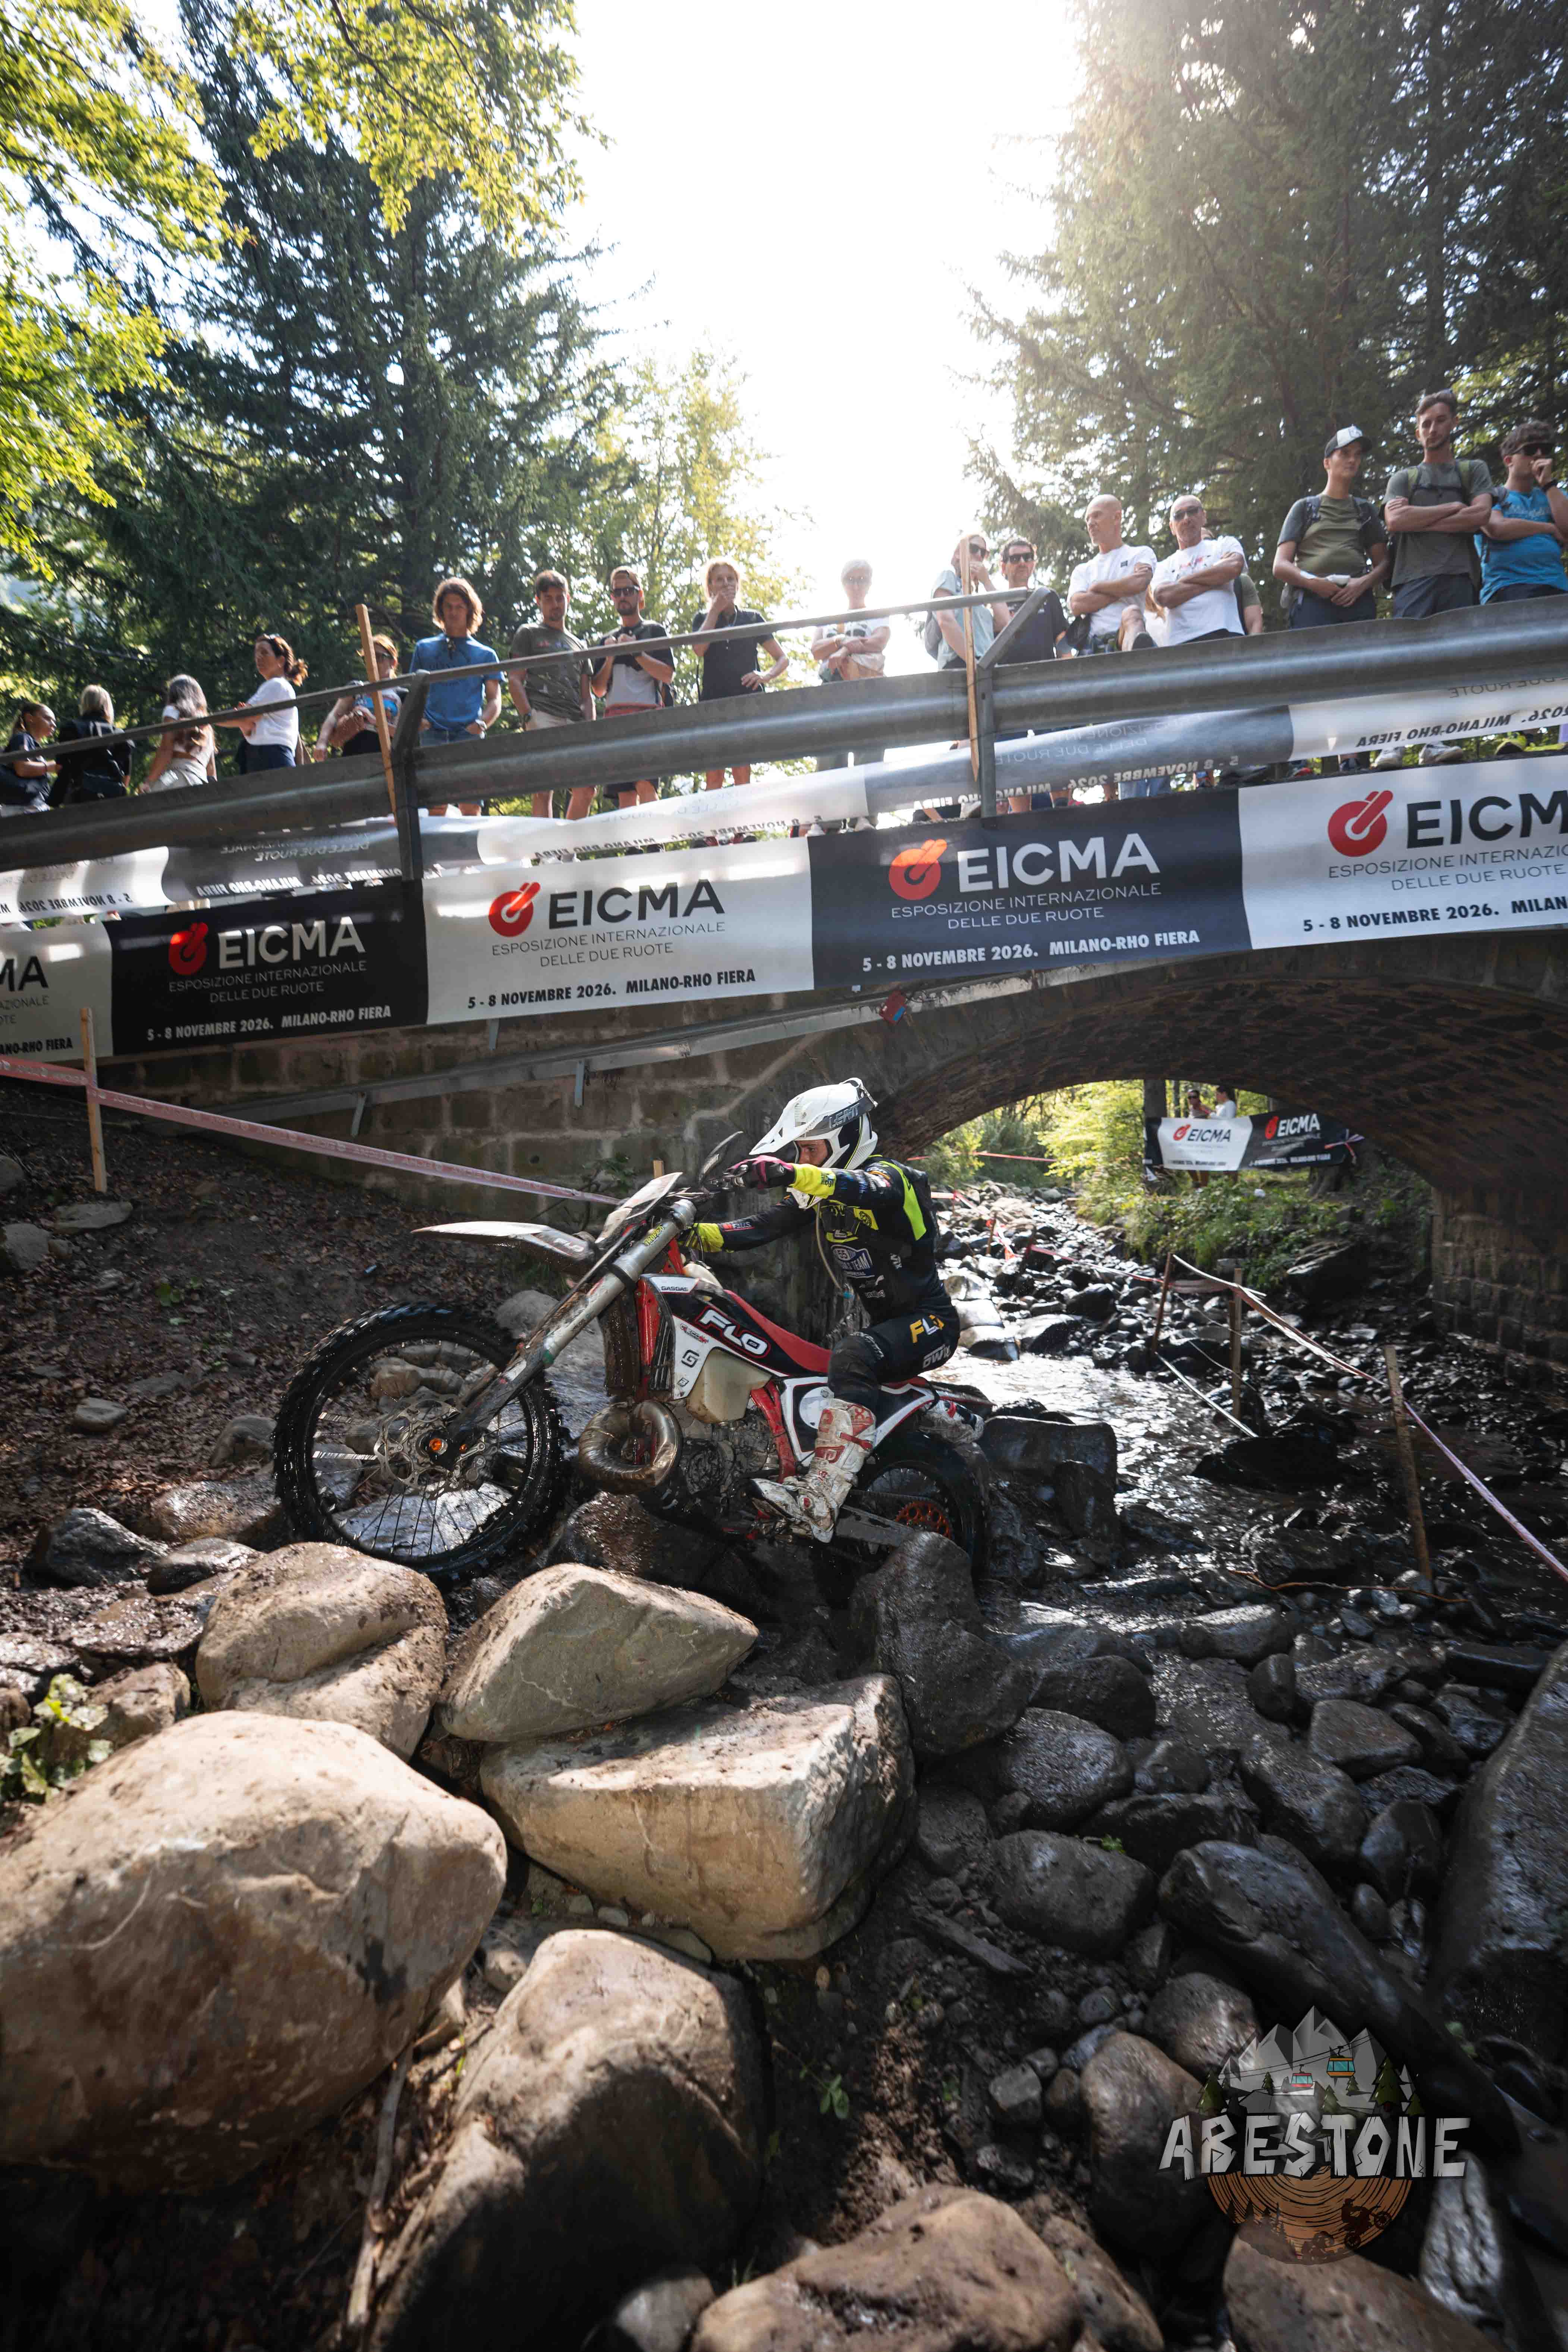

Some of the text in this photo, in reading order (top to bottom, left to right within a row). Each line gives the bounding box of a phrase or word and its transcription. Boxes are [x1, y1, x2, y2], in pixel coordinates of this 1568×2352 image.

[957, 832, 1160, 893] EICMA
[1329, 855, 1454, 878] ESPOSIZIONE
[1392, 864, 1567, 891] DELLE DUE RUOTE
[549, 879, 725, 929] EICMA
[891, 883, 1162, 918] ESPOSIZIONE INTERNAZIONALE
[948, 907, 1105, 930] DELLE DUE RUOTE
[1303, 920, 1313, 932] 5
[1330, 917, 1341, 930] 8
[1347, 908, 1440, 928] NOVEMBRE
[1446, 903, 1500, 920] 2026.
[218, 916, 365, 969] EICMA
[492, 921, 725, 956] ESPOSIZIONE INTERNAZIONALE
[540, 942, 673, 967] DELLE DUE RUOTE
[862, 958, 871, 972] 5
[886, 955, 896, 969] 8
[902, 946, 986, 968] NOVEMBRE
[991, 943, 1038, 960] 2026.
[1049, 933, 1149, 956] MILANO-RHO
[1154, 929, 1200, 946] FIERA
[169, 960, 367, 993] ESPOSIZIONE INTERNAZIONALE
[210, 981, 324, 1003] DELLE DUE RUOTE
[468, 996, 476, 1009] 5
[488, 995, 496, 1007] 8
[501, 986, 572, 1006] NOVEMBRE
[576, 983, 616, 998] 2026.
[626, 973, 713, 994] MILANO-RHO
[717, 968, 755, 985] FIERA
[147, 1029, 154, 1040] 5
[164, 1027, 172, 1039] 8
[176, 1020, 236, 1038] NOVEMBRE
[240, 1017, 274, 1031] 2026.
[282, 1009, 355, 1027] MILANO-RHO
[358, 1005, 392, 1020] FIERA
[46, 1037, 73, 1050] FIERA
[1187, 1129, 1231, 1142] EICMA
[1277, 1113, 1320, 1137] EICMA
[698, 1309, 768, 1355] FLO
